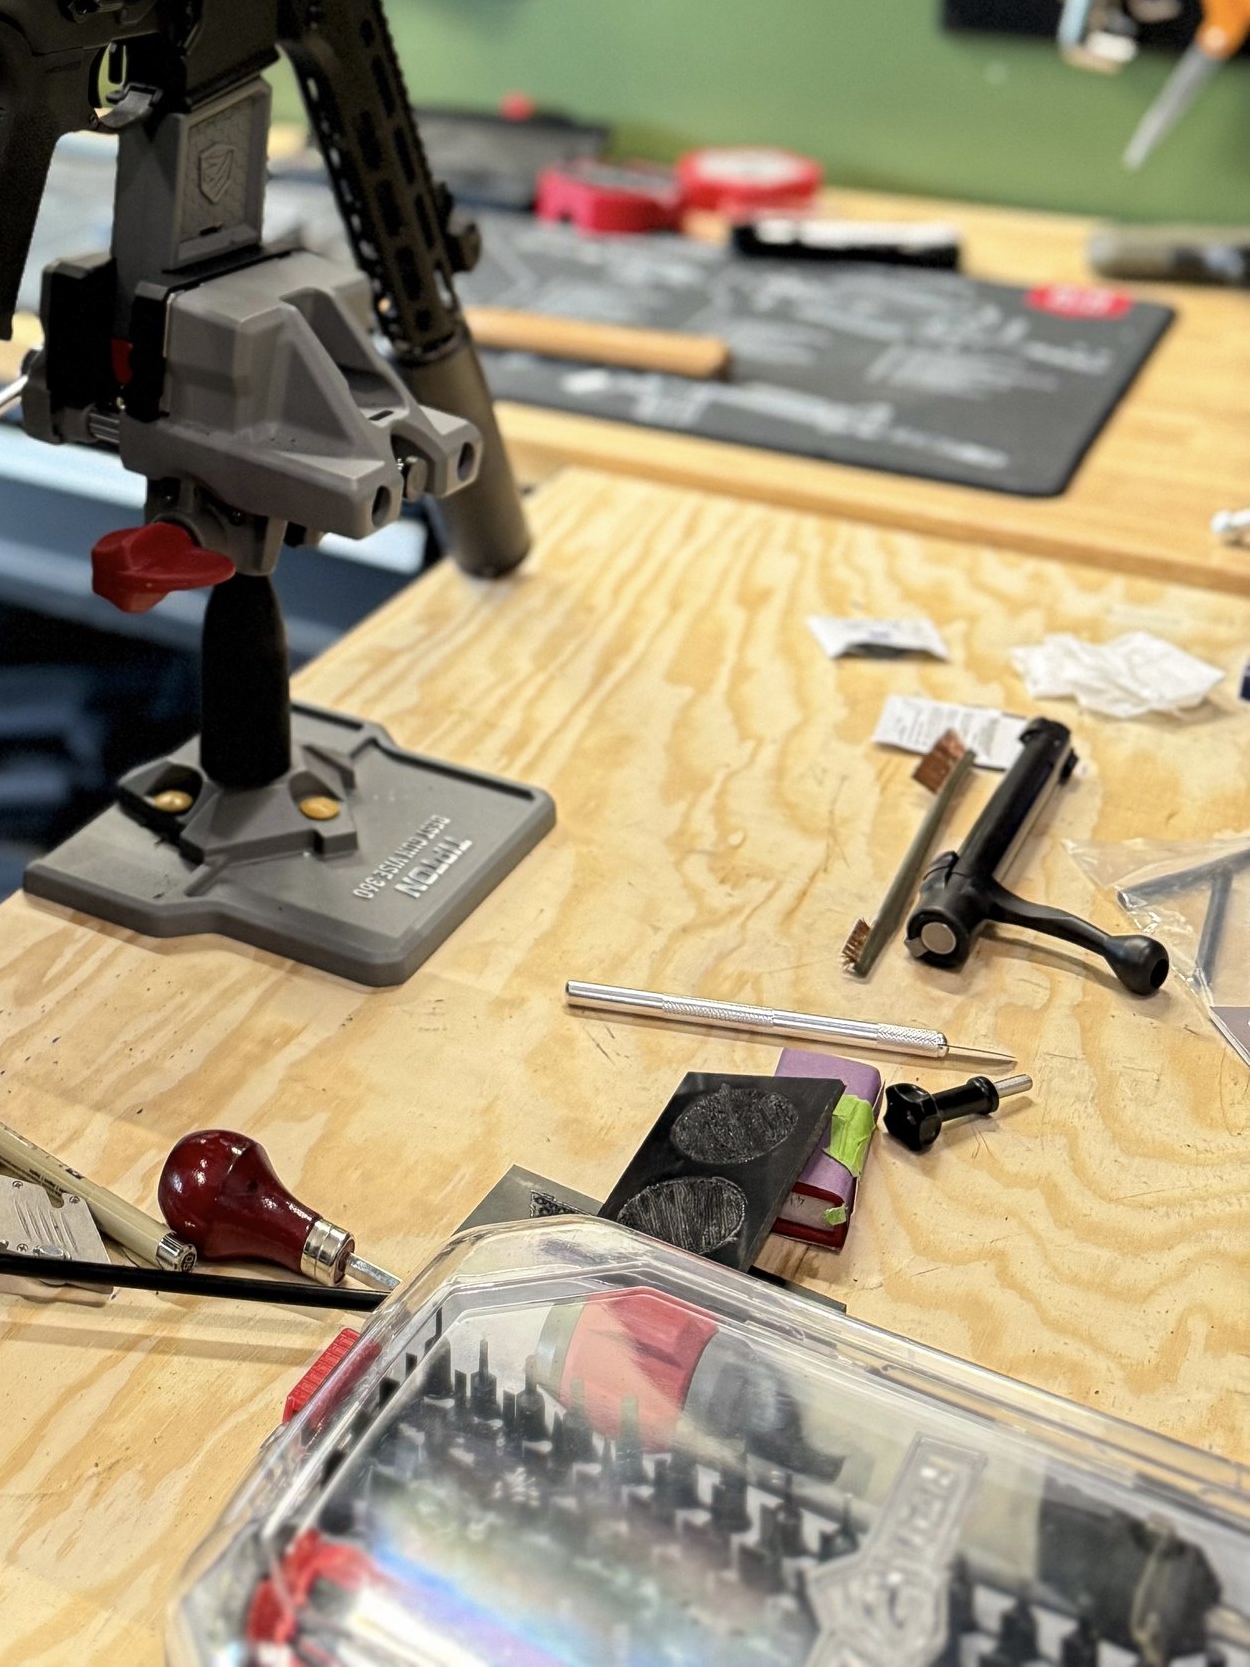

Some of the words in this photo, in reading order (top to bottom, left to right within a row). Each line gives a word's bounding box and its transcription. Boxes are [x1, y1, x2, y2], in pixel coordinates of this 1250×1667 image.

[372, 856, 409, 881] VISE
[394, 835, 473, 899] TIPTON
[352, 877, 387, 900] 360
